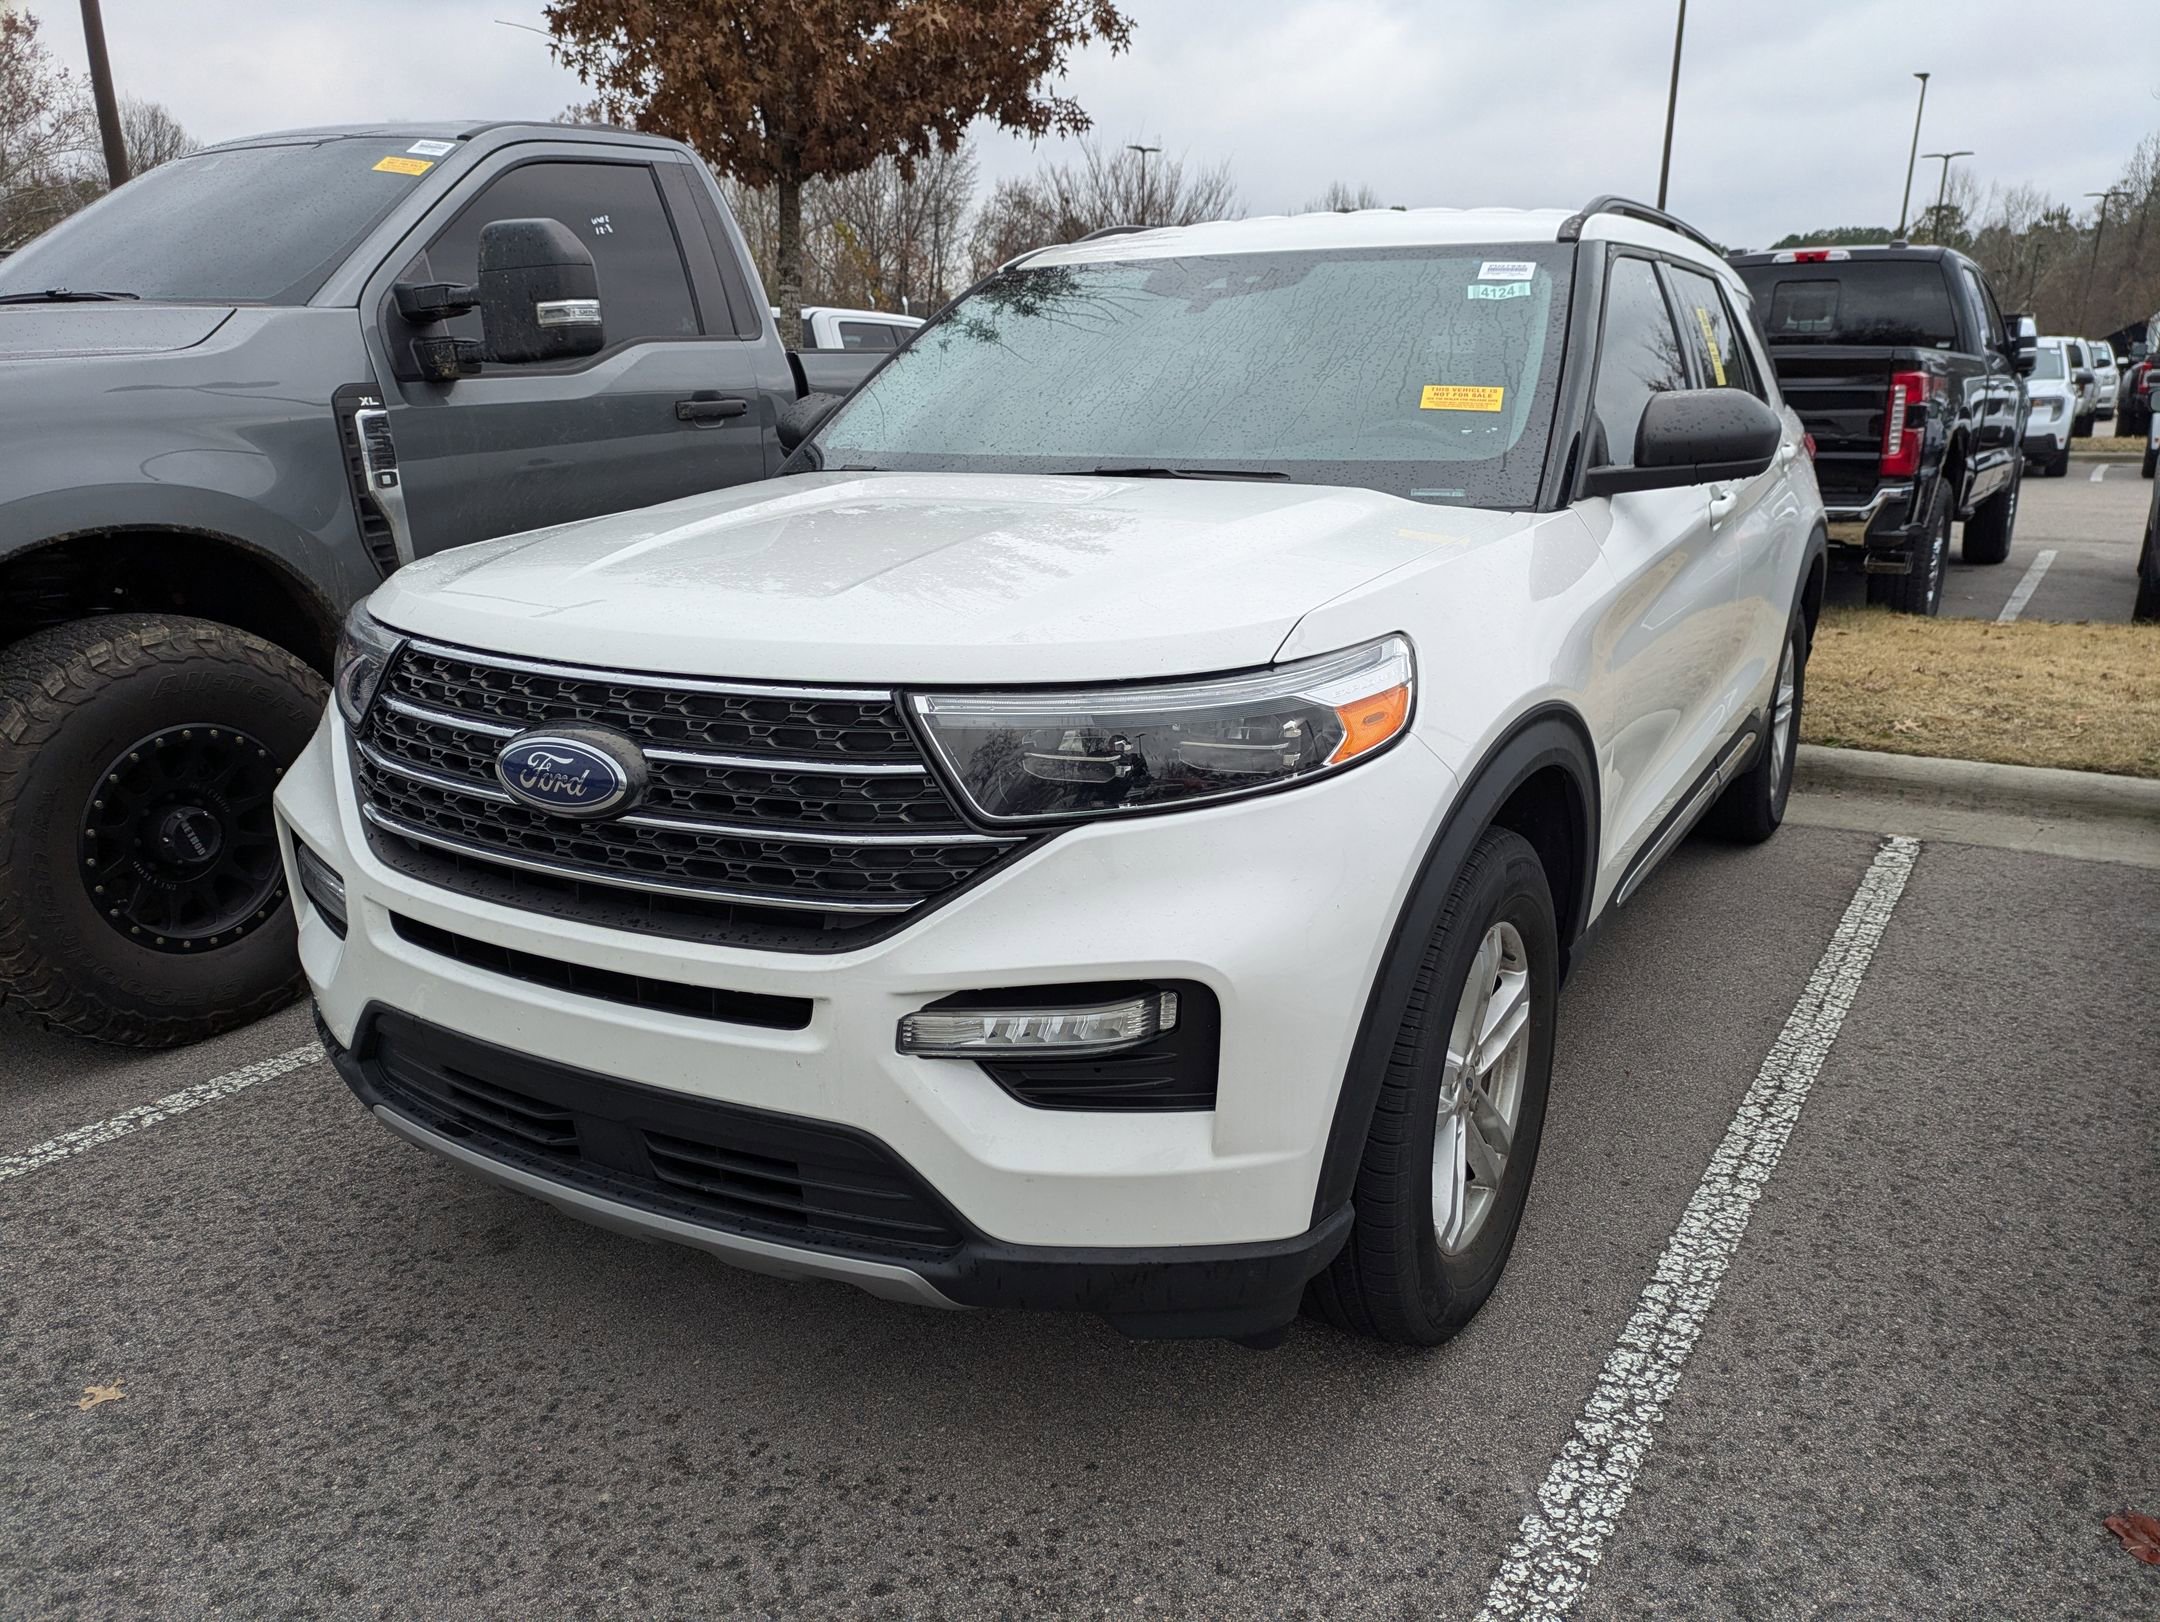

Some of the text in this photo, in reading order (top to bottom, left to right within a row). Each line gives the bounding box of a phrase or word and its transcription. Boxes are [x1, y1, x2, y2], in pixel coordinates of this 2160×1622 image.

[1481, 285, 1514, 298] 4124
[357, 396, 380, 407] XL
[519, 751, 591, 797] Ford
